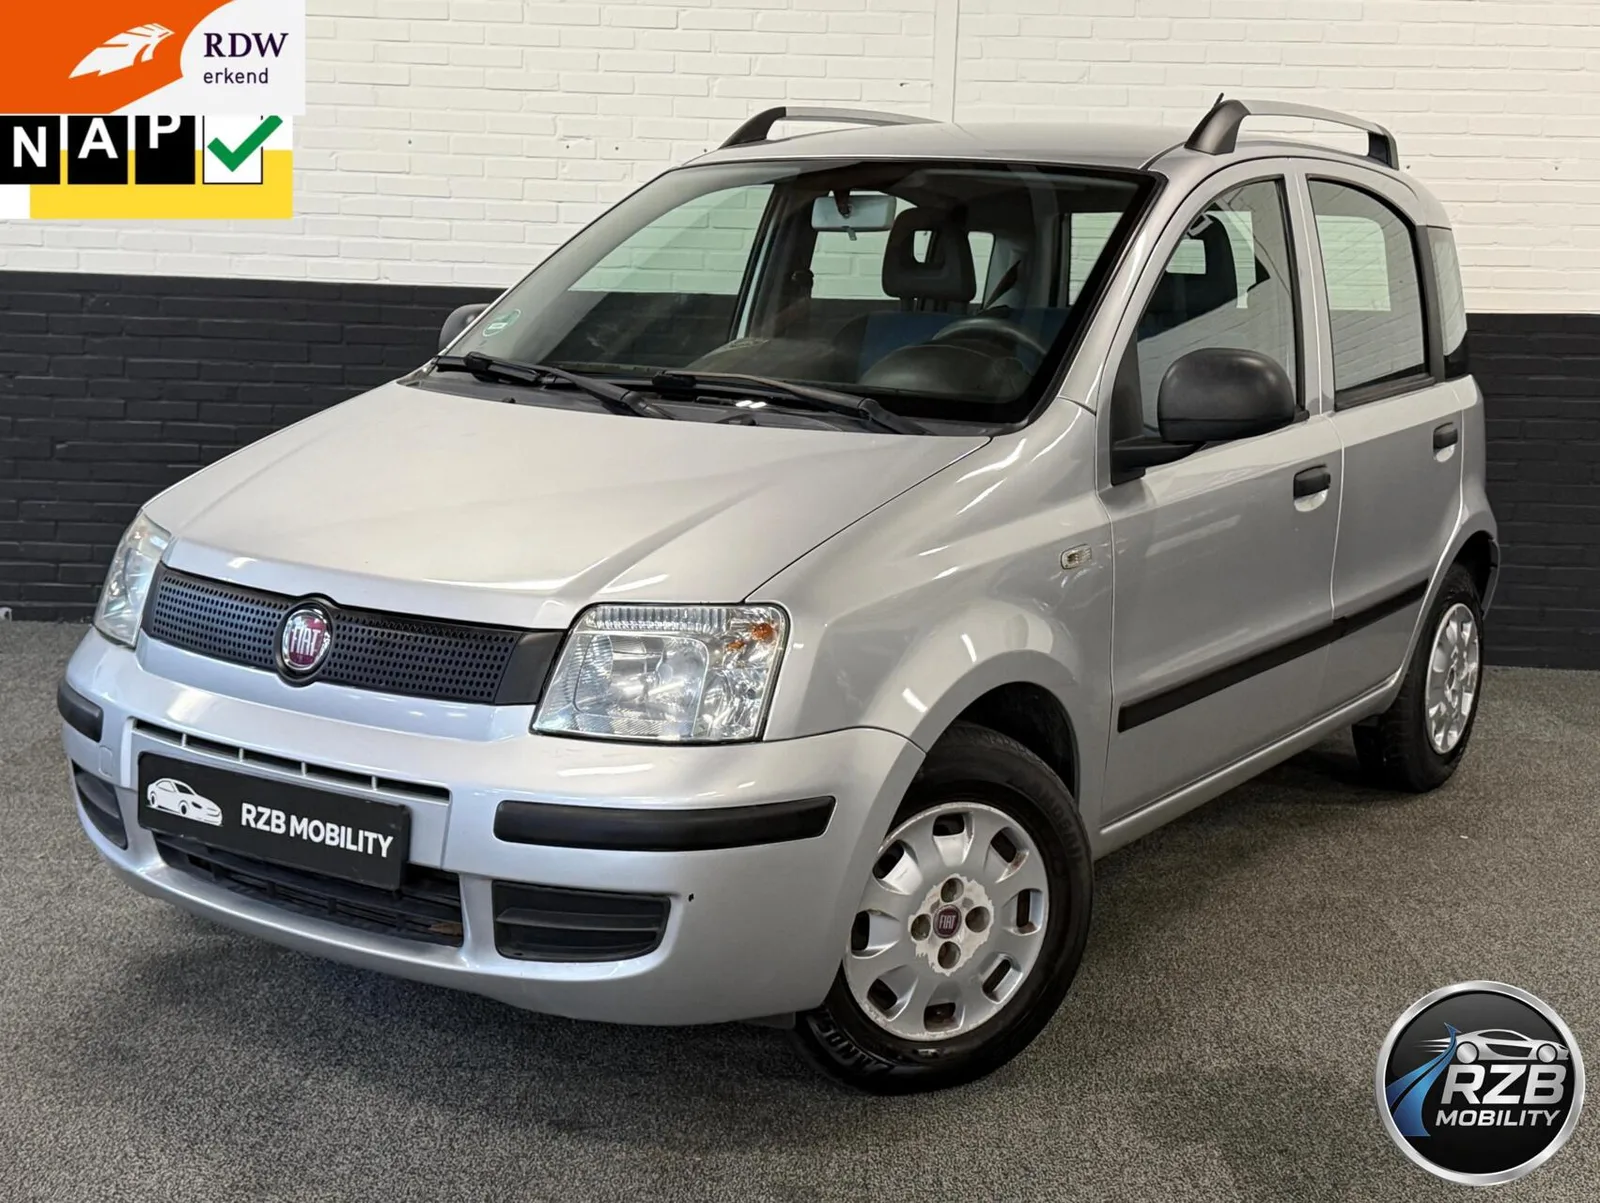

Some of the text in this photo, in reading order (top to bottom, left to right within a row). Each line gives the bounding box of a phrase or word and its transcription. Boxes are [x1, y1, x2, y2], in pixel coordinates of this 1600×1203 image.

[290, 626, 322, 656] FIAT
[240, 802, 394, 858] RZB MOBILITY
[938, 914, 957, 930] FIAT
